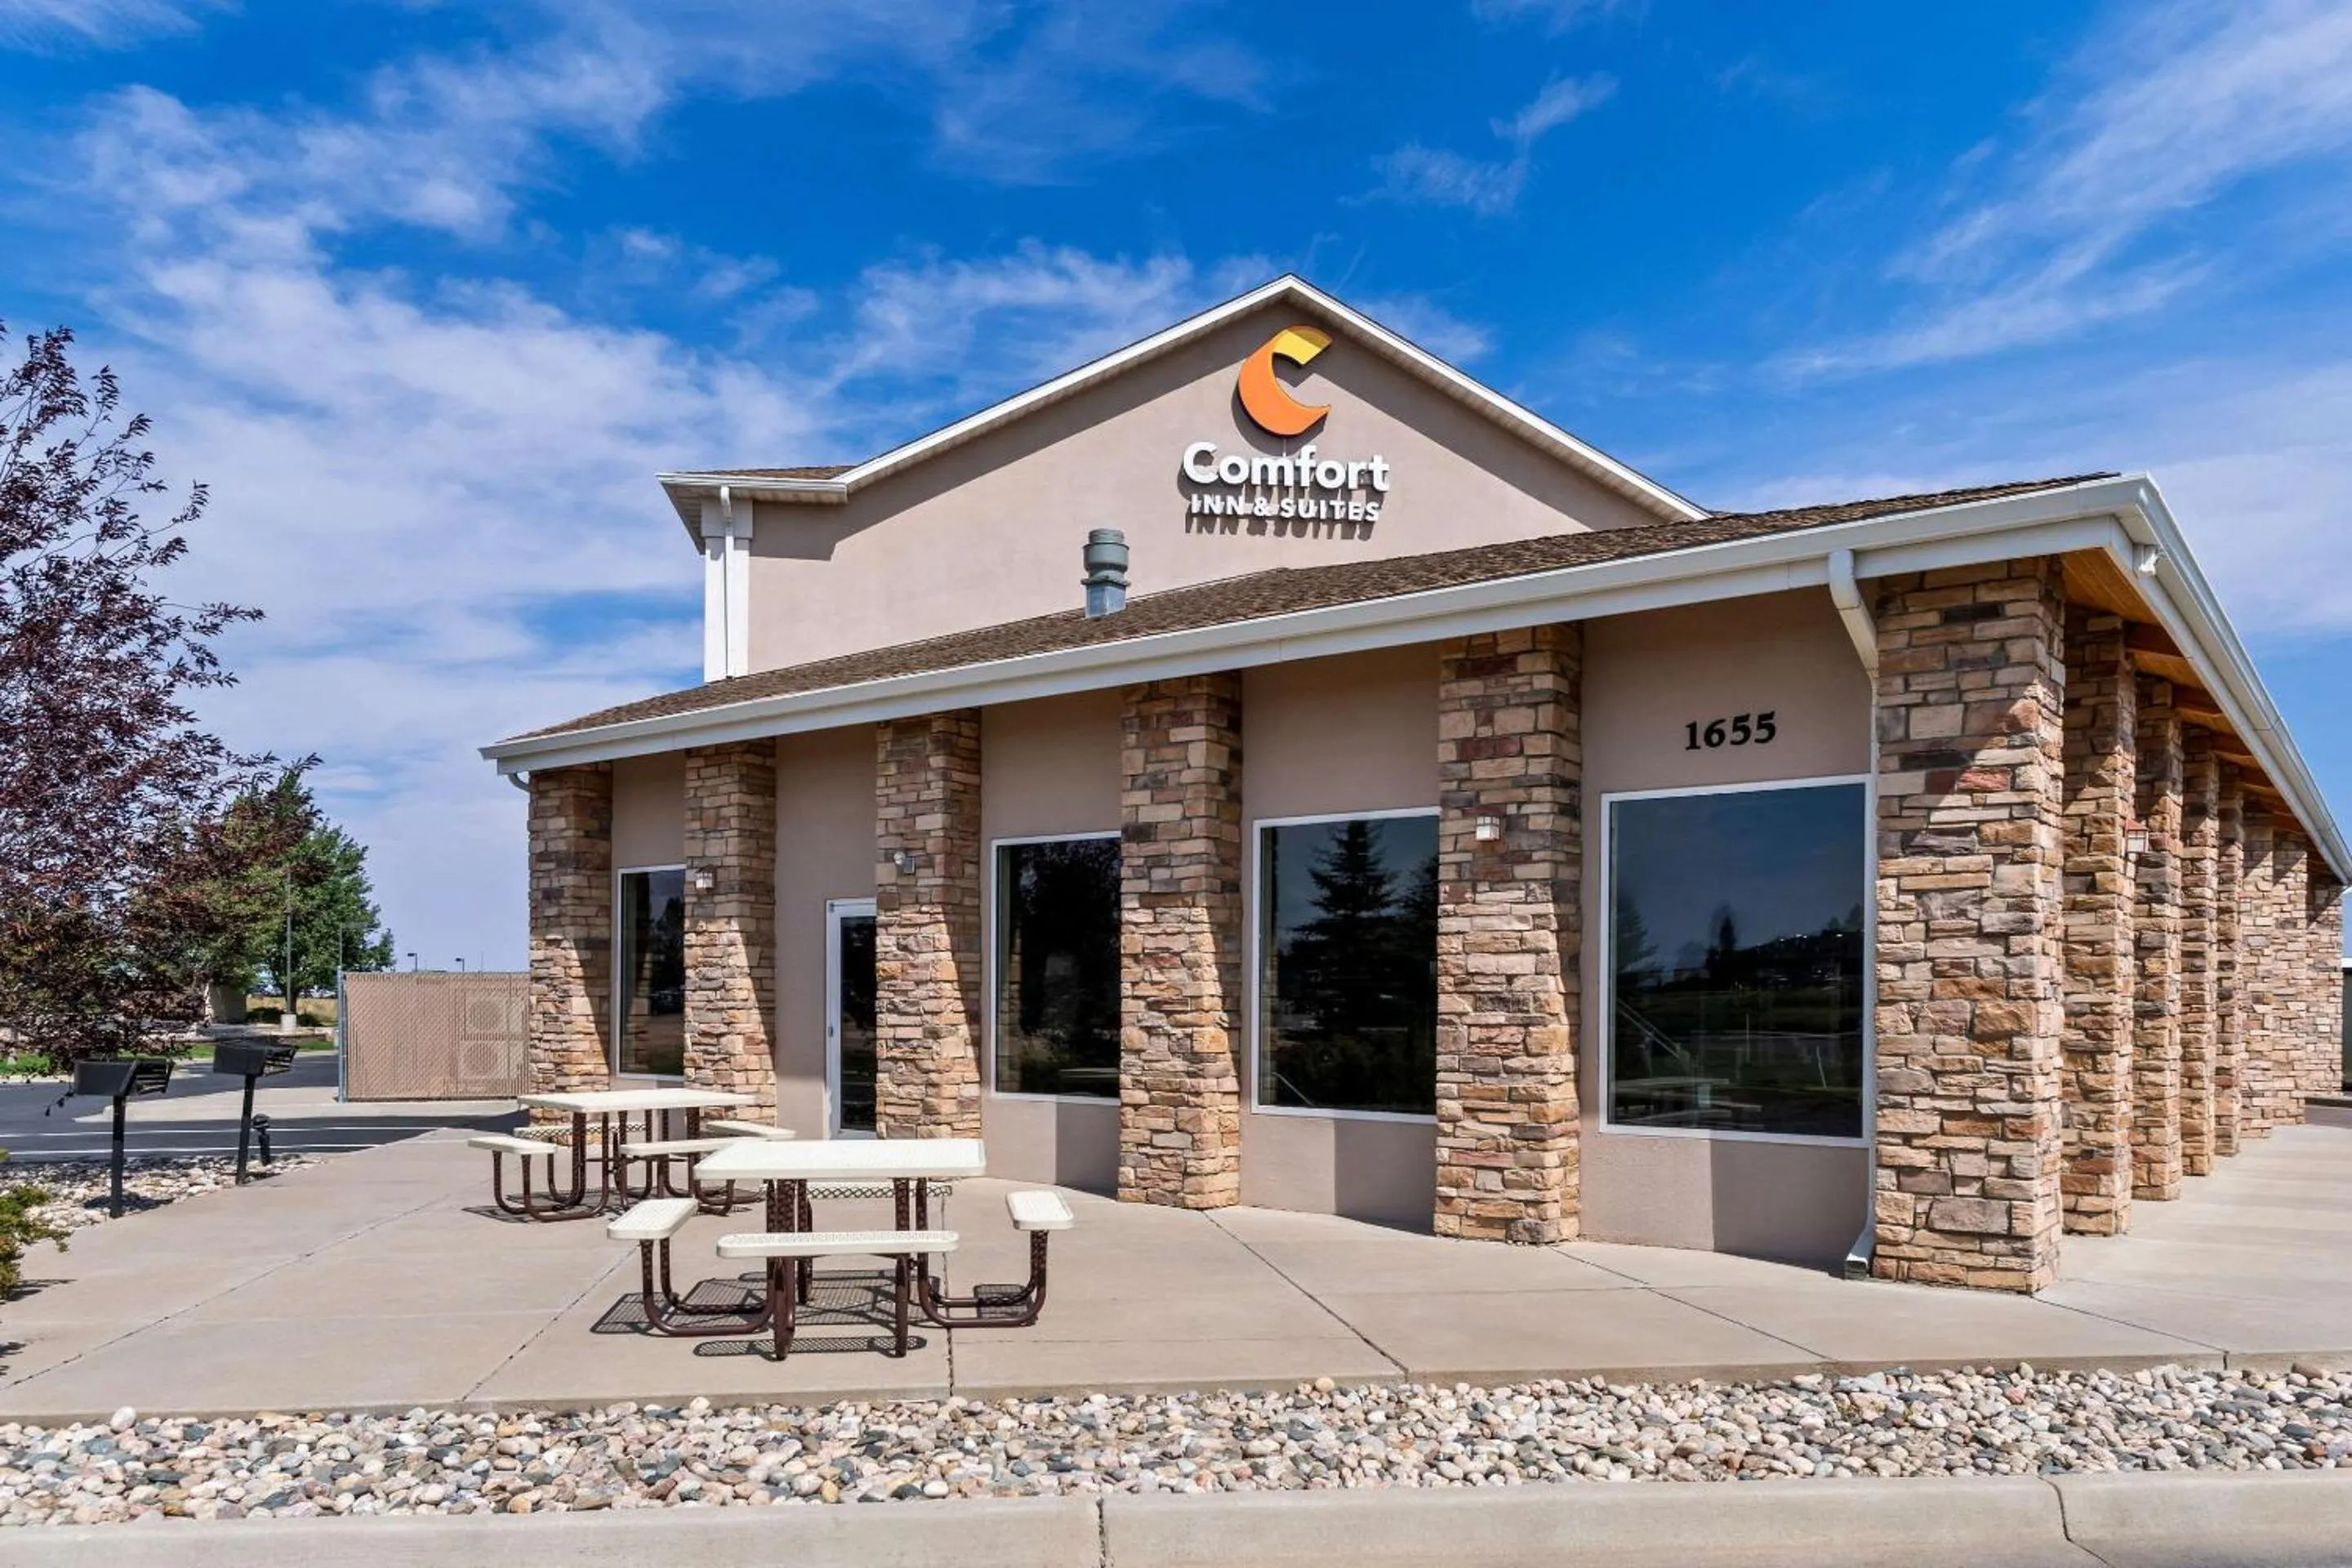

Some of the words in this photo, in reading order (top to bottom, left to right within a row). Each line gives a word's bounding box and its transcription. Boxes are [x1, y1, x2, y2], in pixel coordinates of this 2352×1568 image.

[1183, 442, 1390, 492] Comfort
[1192, 493, 1245, 516] INN
[1253, 497, 1272, 519] &
[1280, 497, 1380, 522] SUITES
[1685, 710, 1776, 751] 1655
